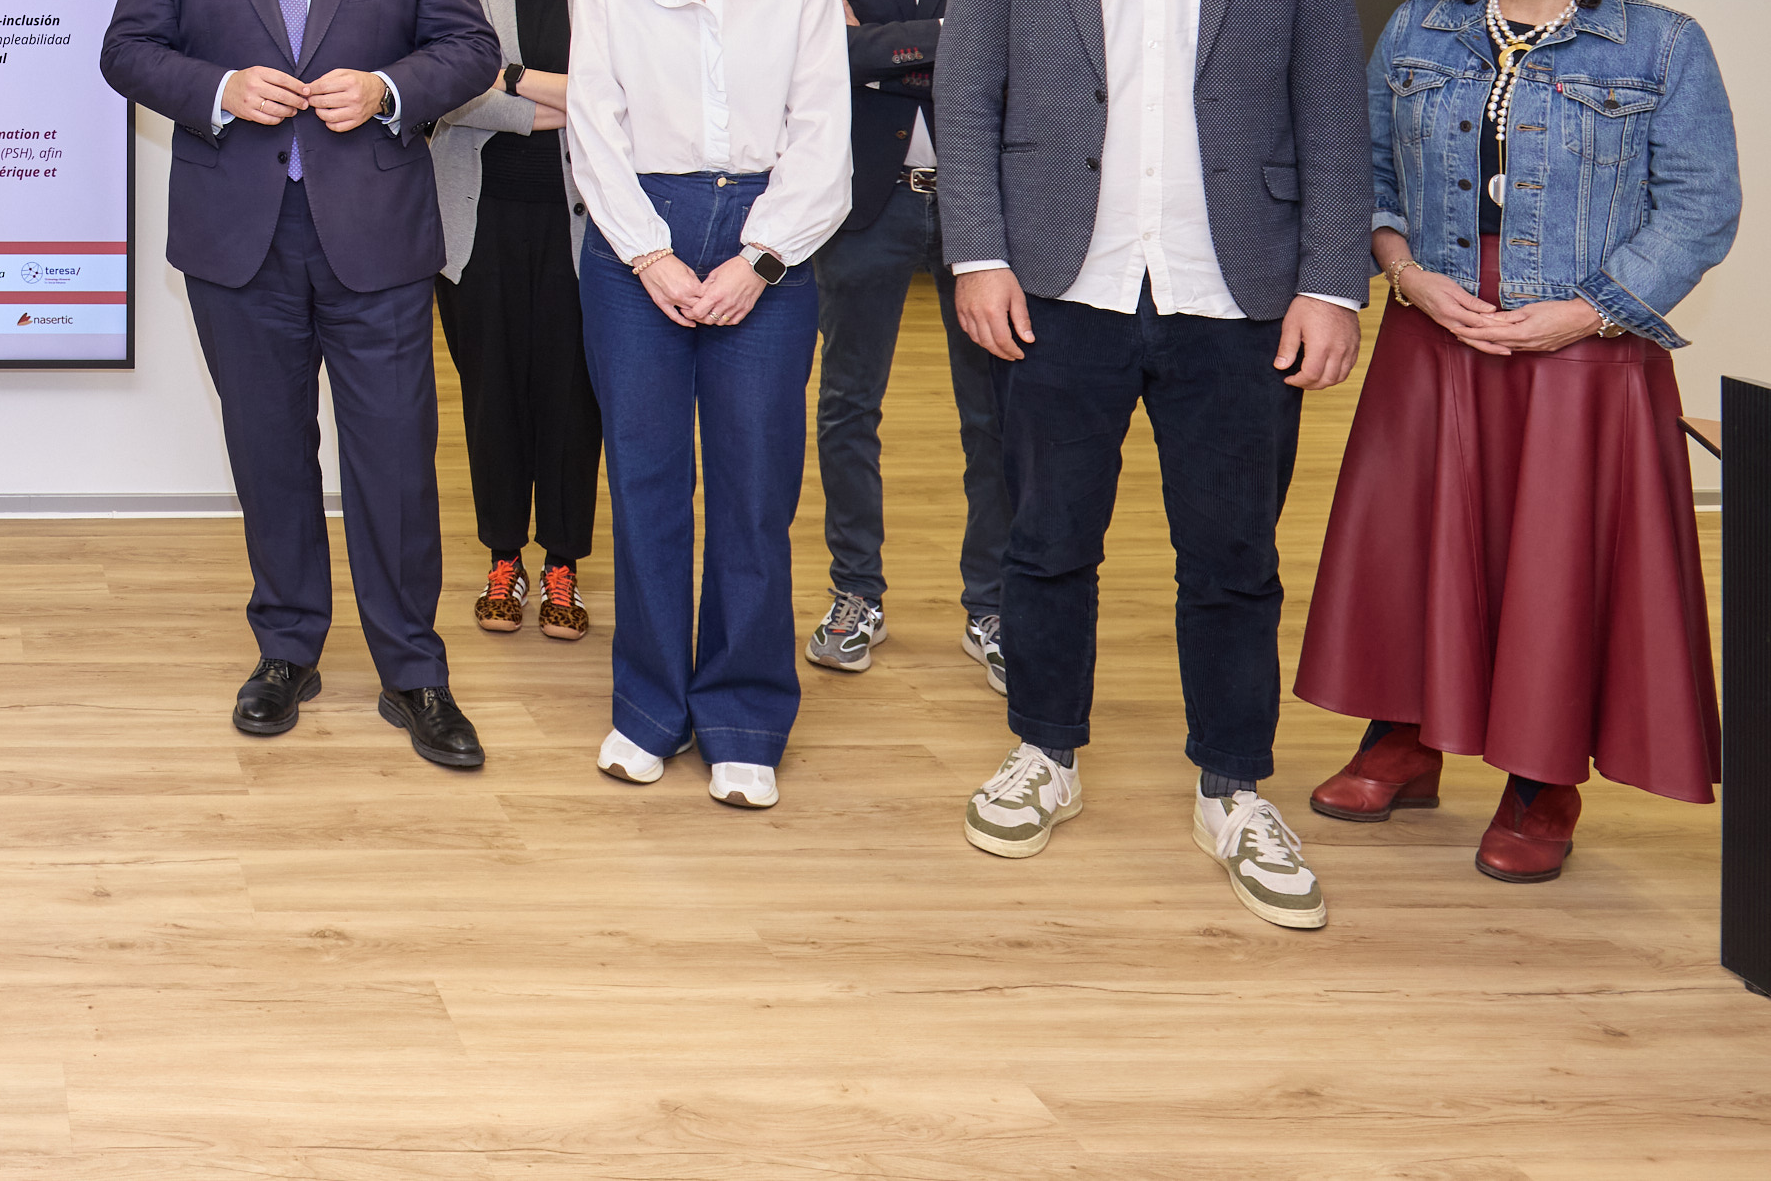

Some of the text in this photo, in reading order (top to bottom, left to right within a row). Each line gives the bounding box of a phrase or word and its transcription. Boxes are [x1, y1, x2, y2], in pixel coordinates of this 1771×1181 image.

[44, 130, 57, 140] et
[1, 148, 35, 160] (PSH),
[39, 147, 62, 162] afin
[44, 167, 57, 177] et
[34, 315, 73, 324] nasertic
